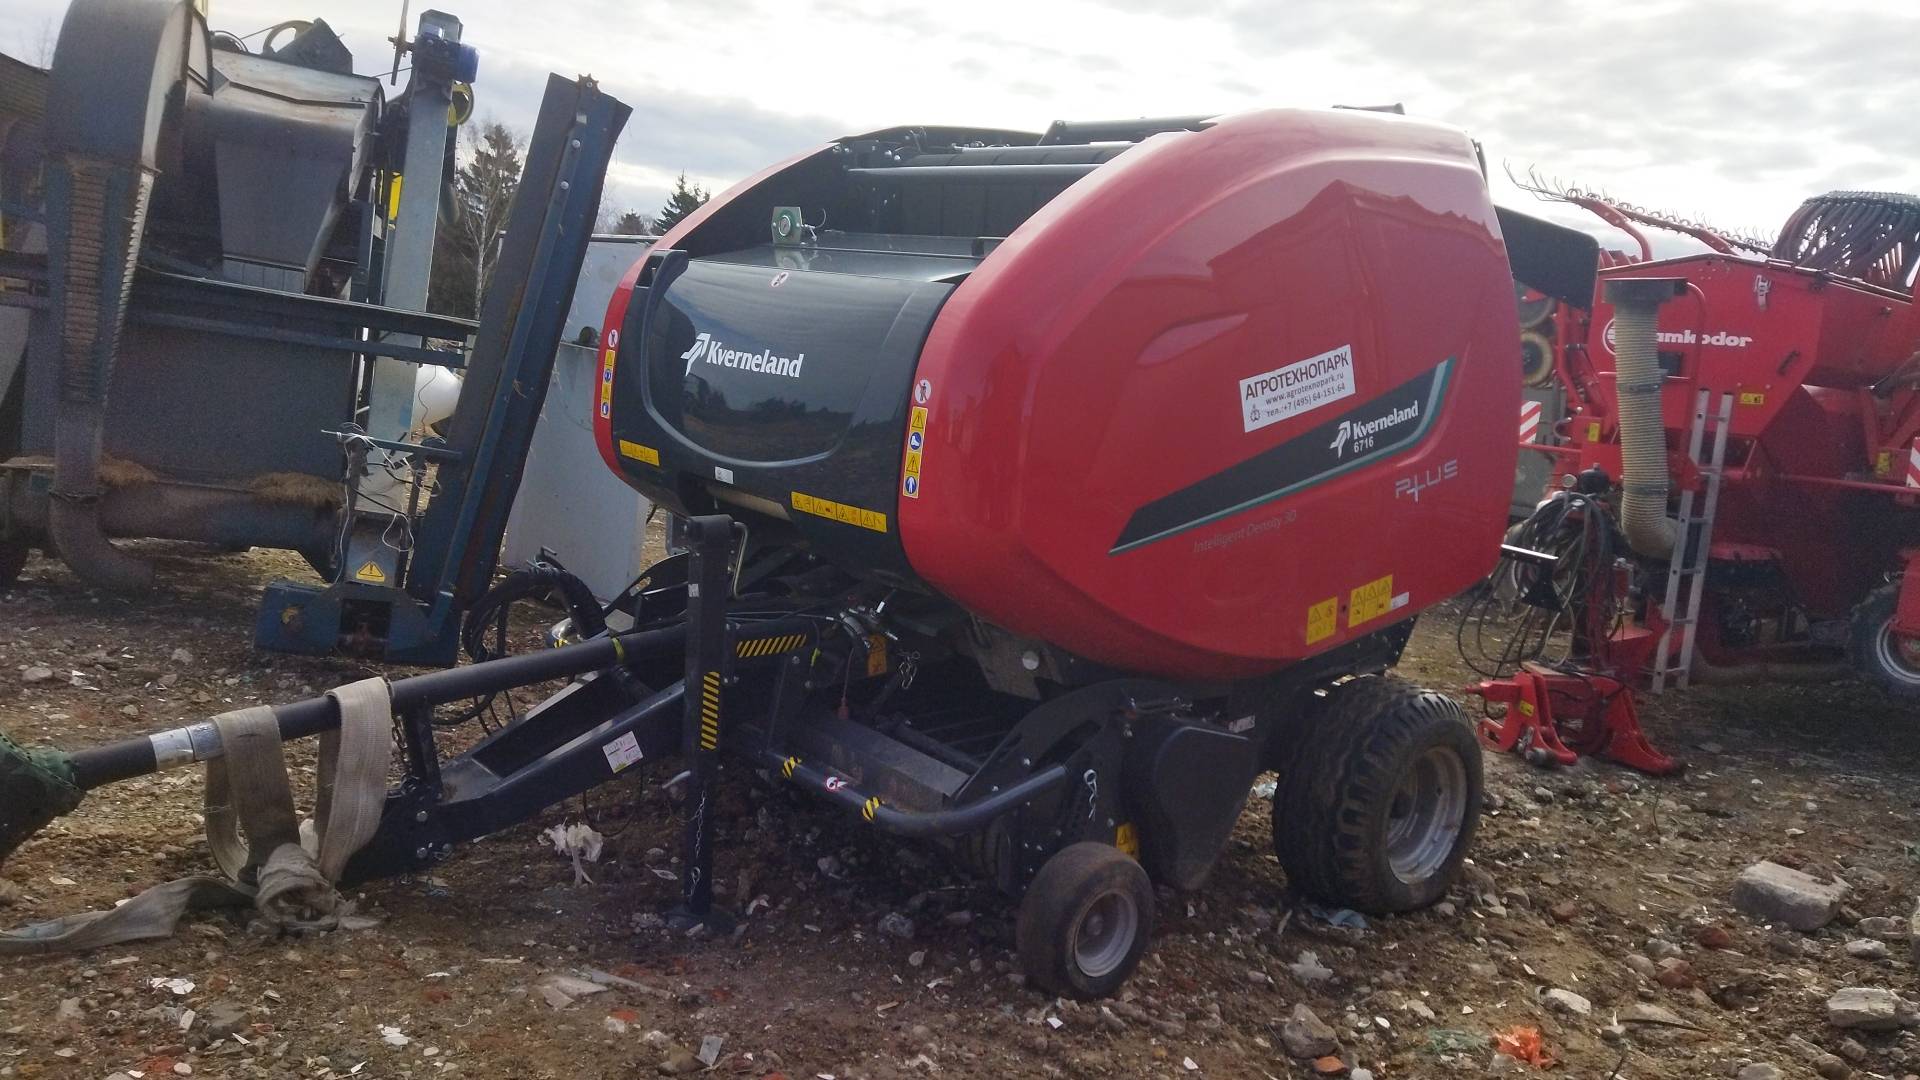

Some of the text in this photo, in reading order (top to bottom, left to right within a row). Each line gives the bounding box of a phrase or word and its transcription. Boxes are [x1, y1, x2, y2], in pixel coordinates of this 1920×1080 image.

[706, 340, 804, 378] Kverneland
[1246, 351, 1349, 401] АГРОТЕХНОПАРК
[1293, 395, 1312, 411] (495)
[1353, 399, 1419, 440] Kverneland
[1354, 436, 1374, 454] 6716
[1193, 526, 1246, 554] Intelligent
